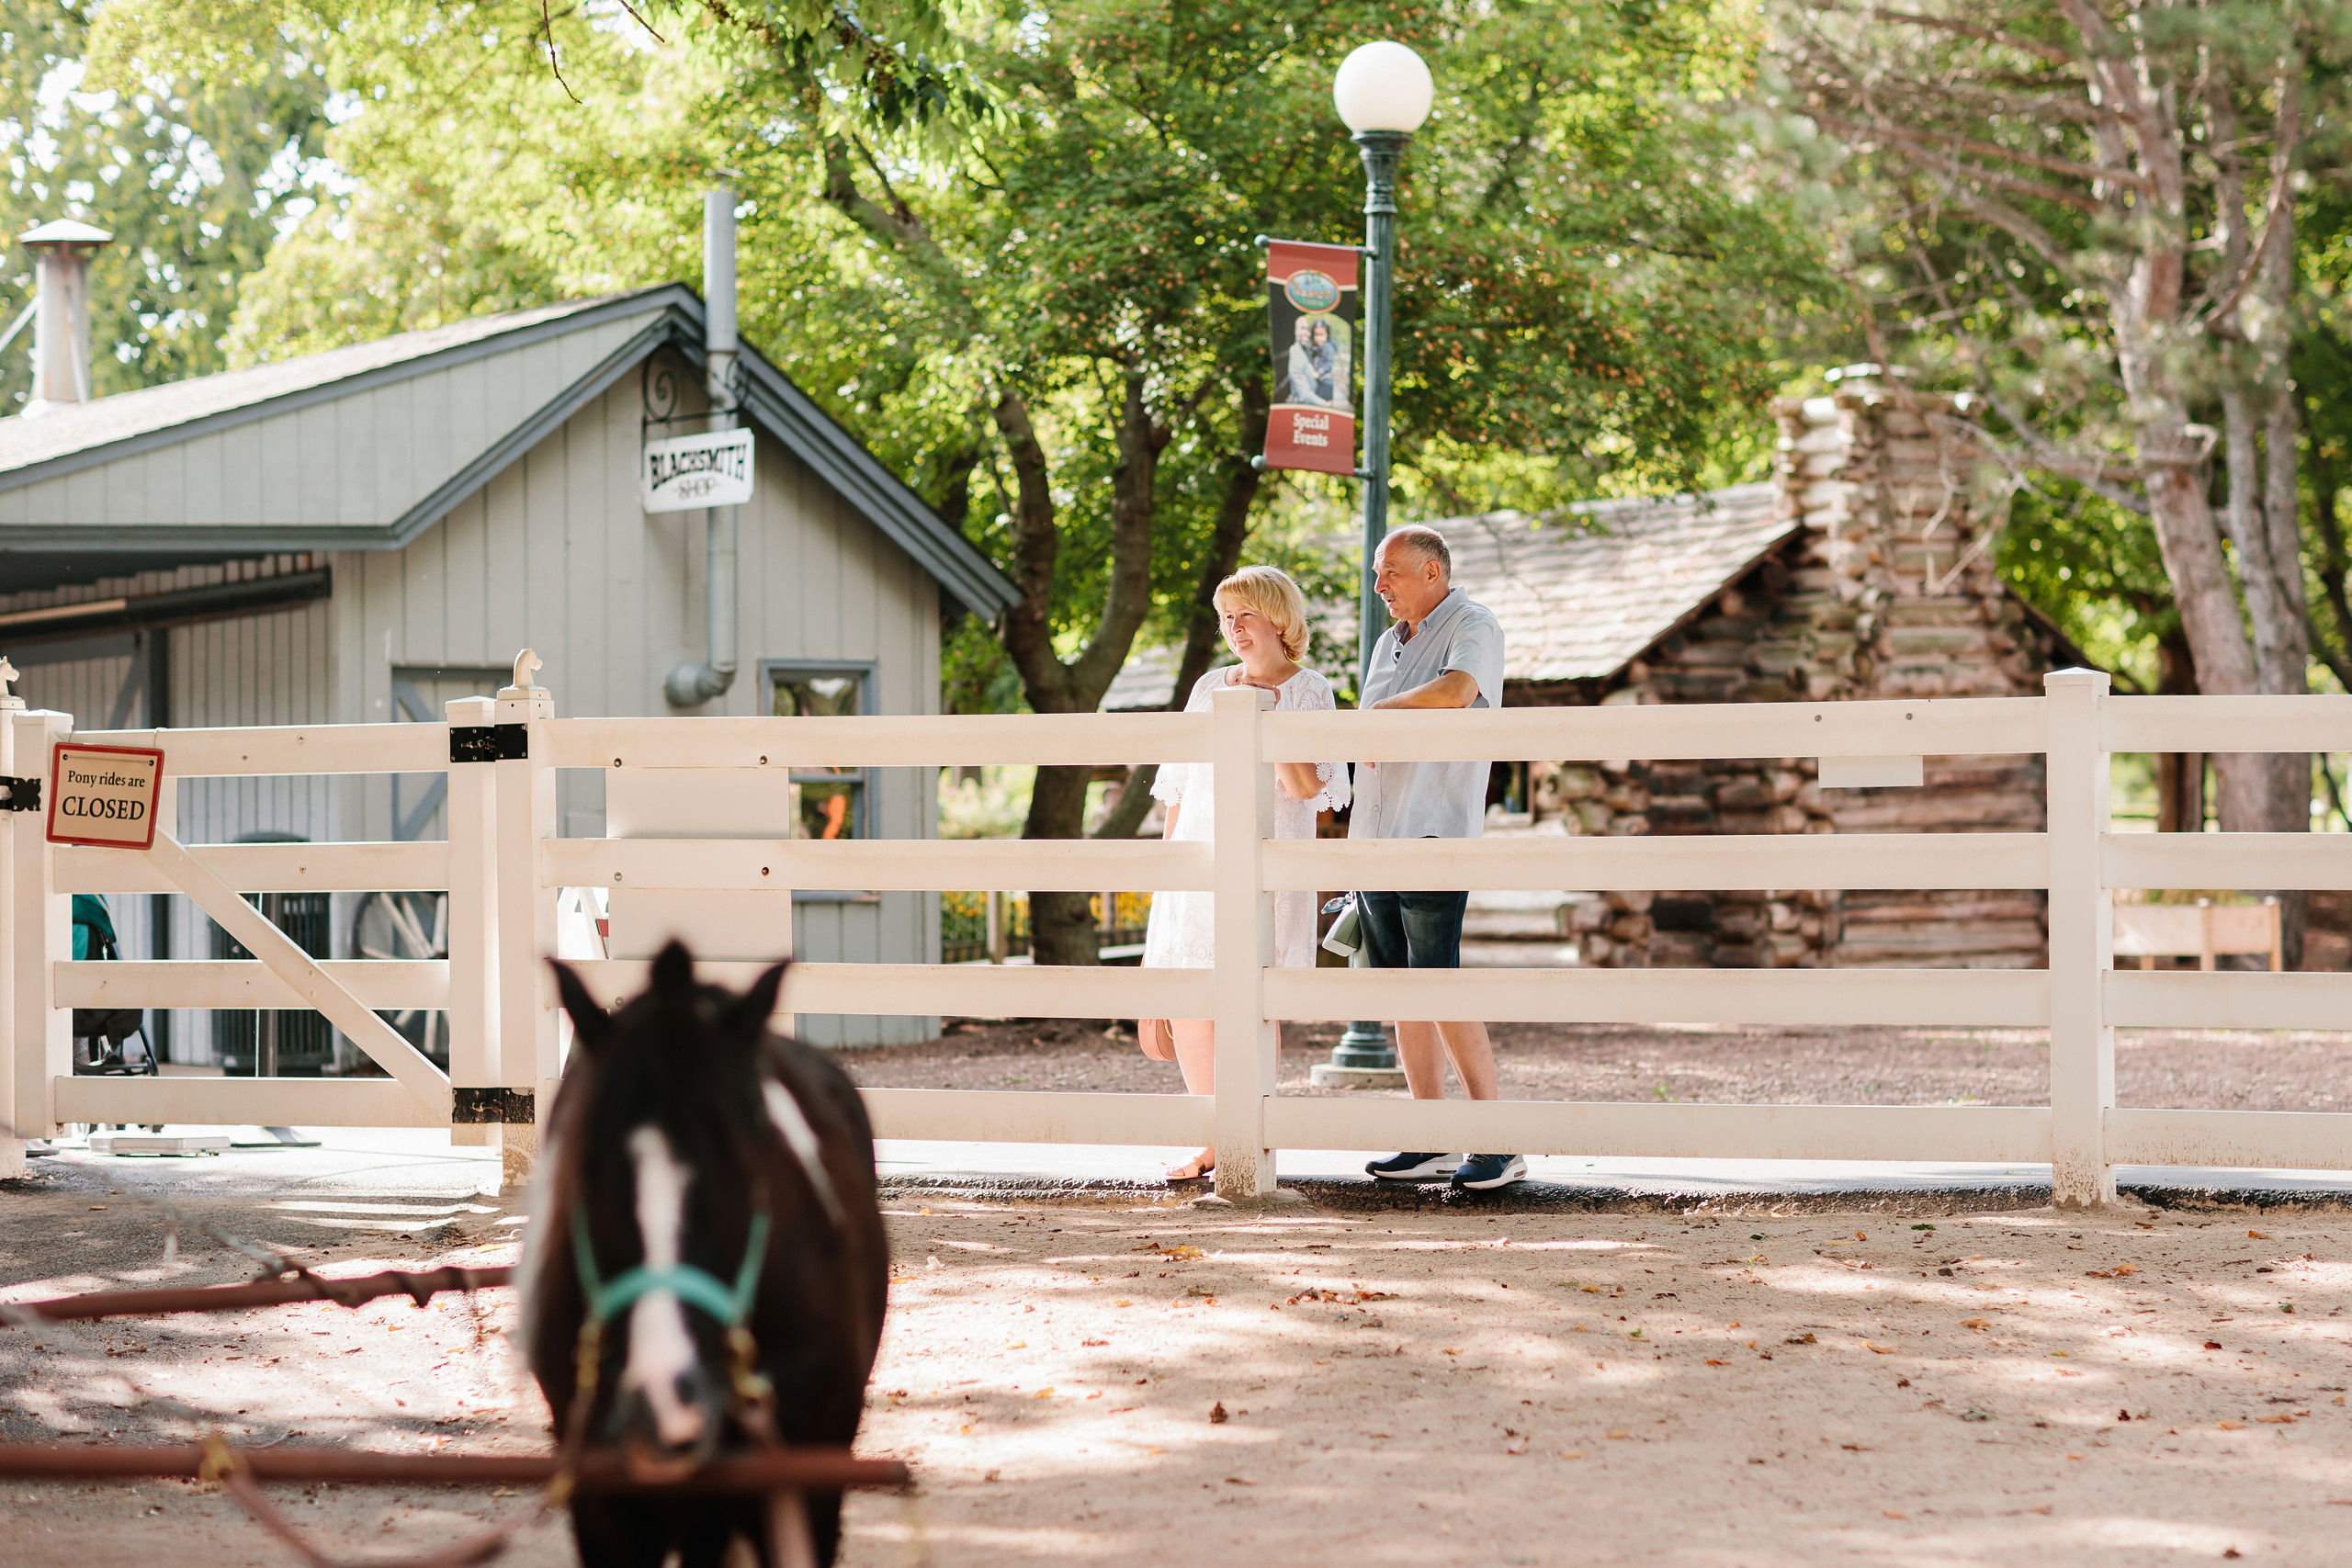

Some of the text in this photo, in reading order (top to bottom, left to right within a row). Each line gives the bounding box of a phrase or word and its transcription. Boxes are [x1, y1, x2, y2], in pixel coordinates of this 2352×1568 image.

[1293, 412, 1329, 431] Special
[1293, 429, 1329, 447] Events
[650, 444, 746, 491] BLACKSMITH
[68, 770, 145, 787] Pony rides are
[62, 796, 145, 820] CLOSED
